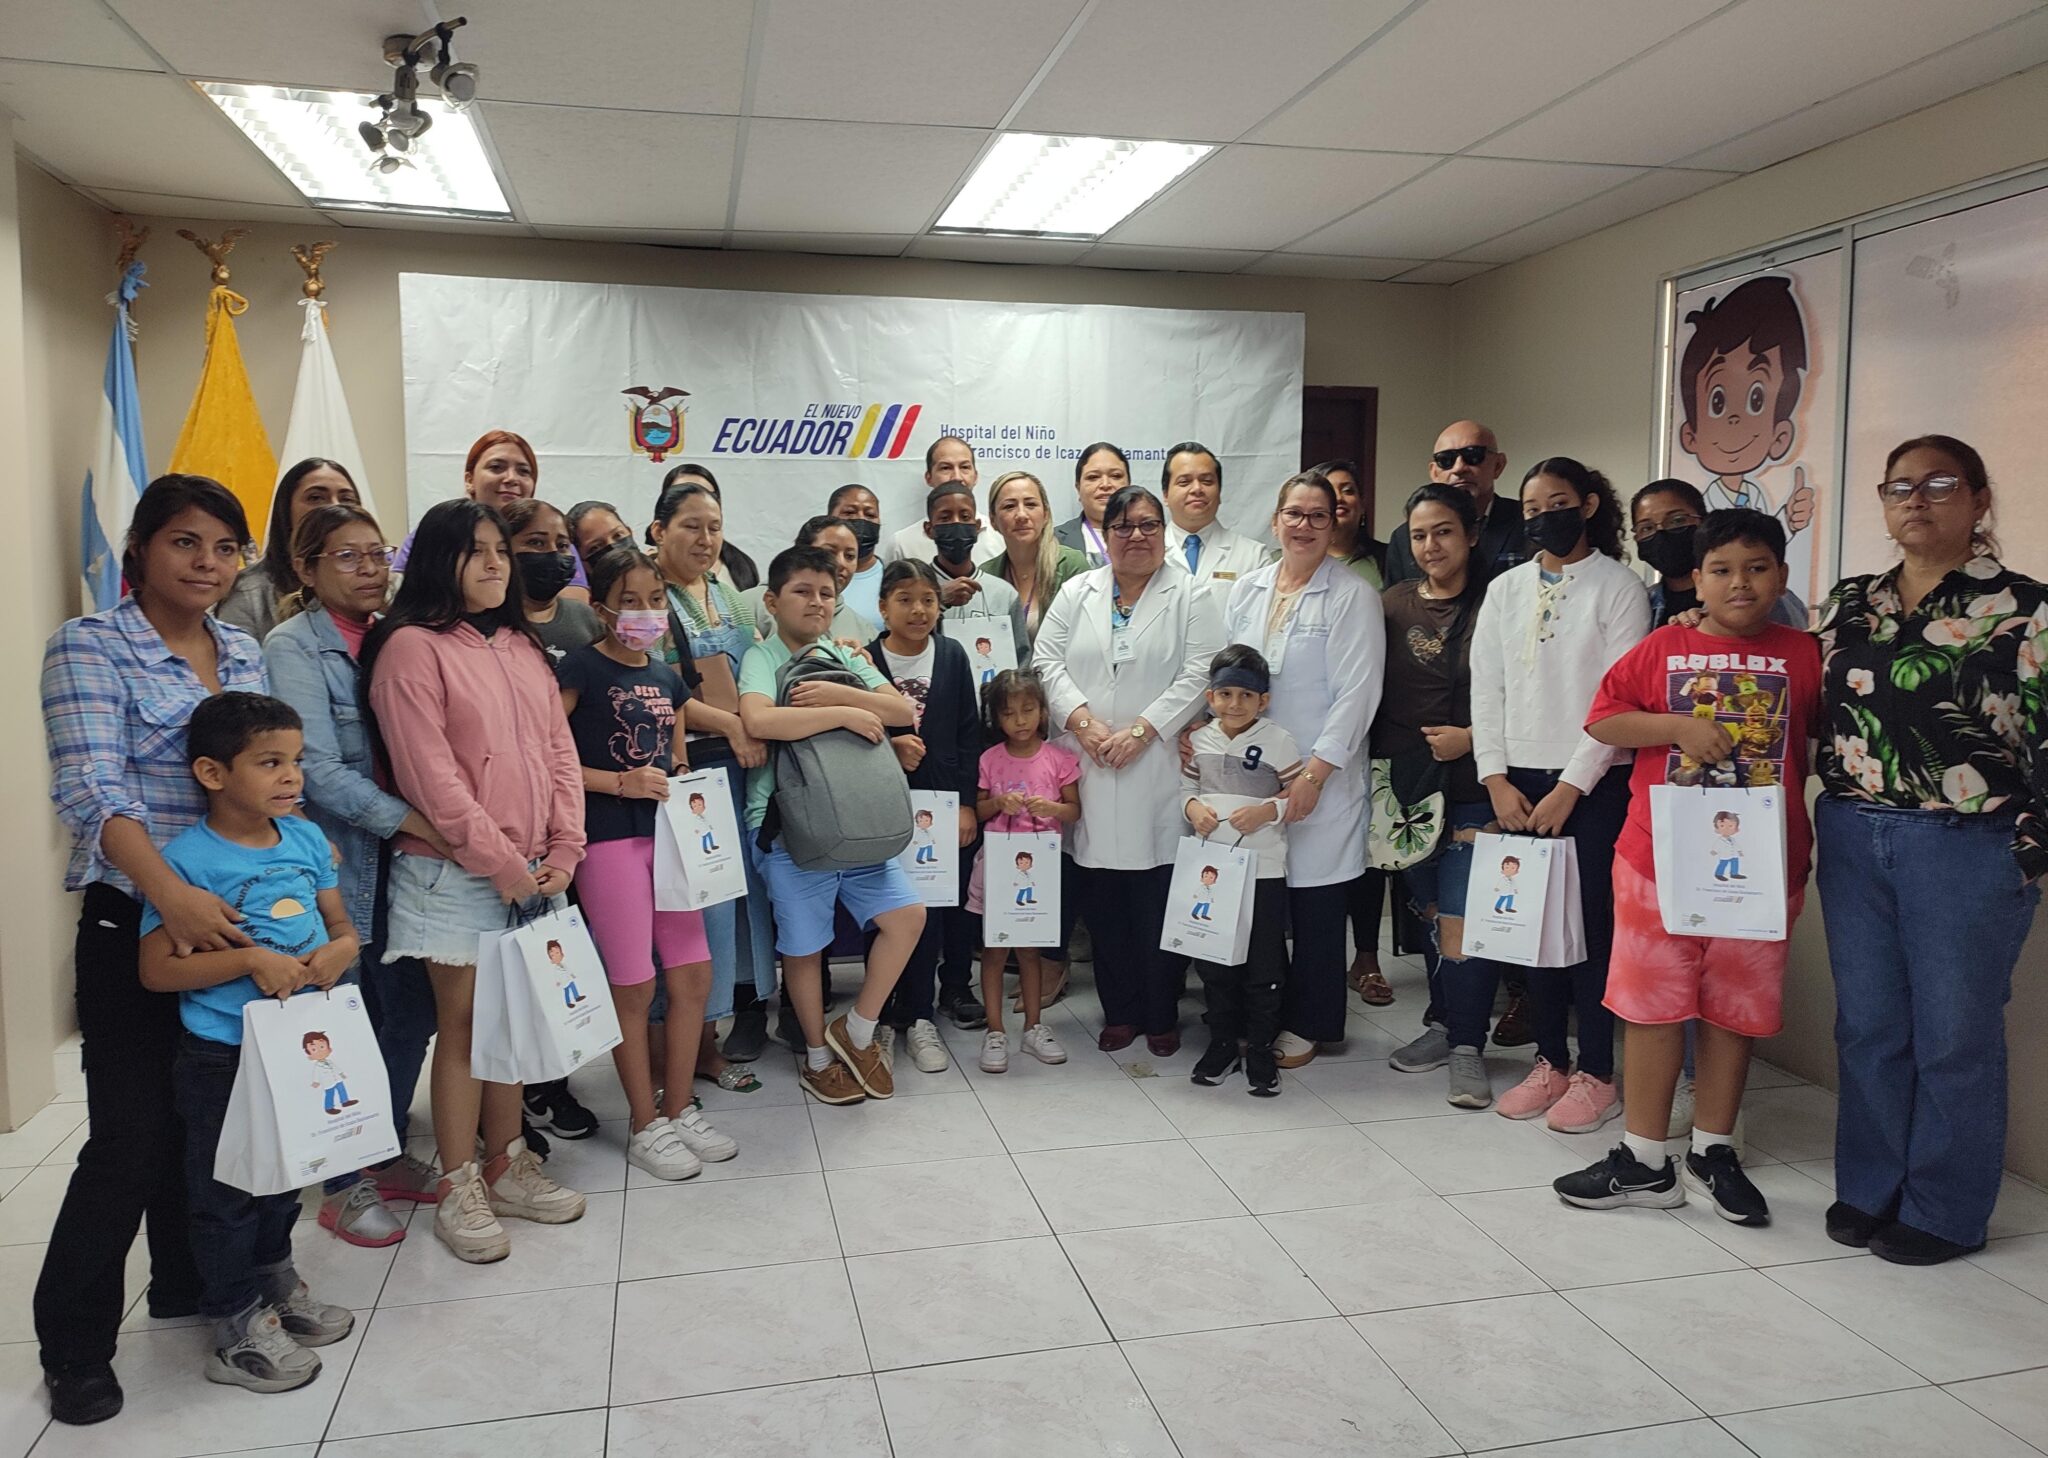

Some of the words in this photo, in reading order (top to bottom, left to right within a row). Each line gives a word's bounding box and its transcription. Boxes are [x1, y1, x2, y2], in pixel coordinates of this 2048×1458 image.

[803, 403, 818, 418] EL
[820, 404, 863, 419] NUEVO
[711, 417, 855, 456] ECUADOR
[940, 424, 996, 442] Hospital
[1000, 425, 1021, 440] del
[1025, 425, 1056, 440] Niño
[970, 444, 1031, 459] rancisco
[1035, 444, 1051, 459] de
[1056, 445, 1081, 460] Icaz
[1666, 653, 1788, 674] ROBLOX
[633, 685, 661, 697] BEST
[1242, 745, 1263, 771] 9
